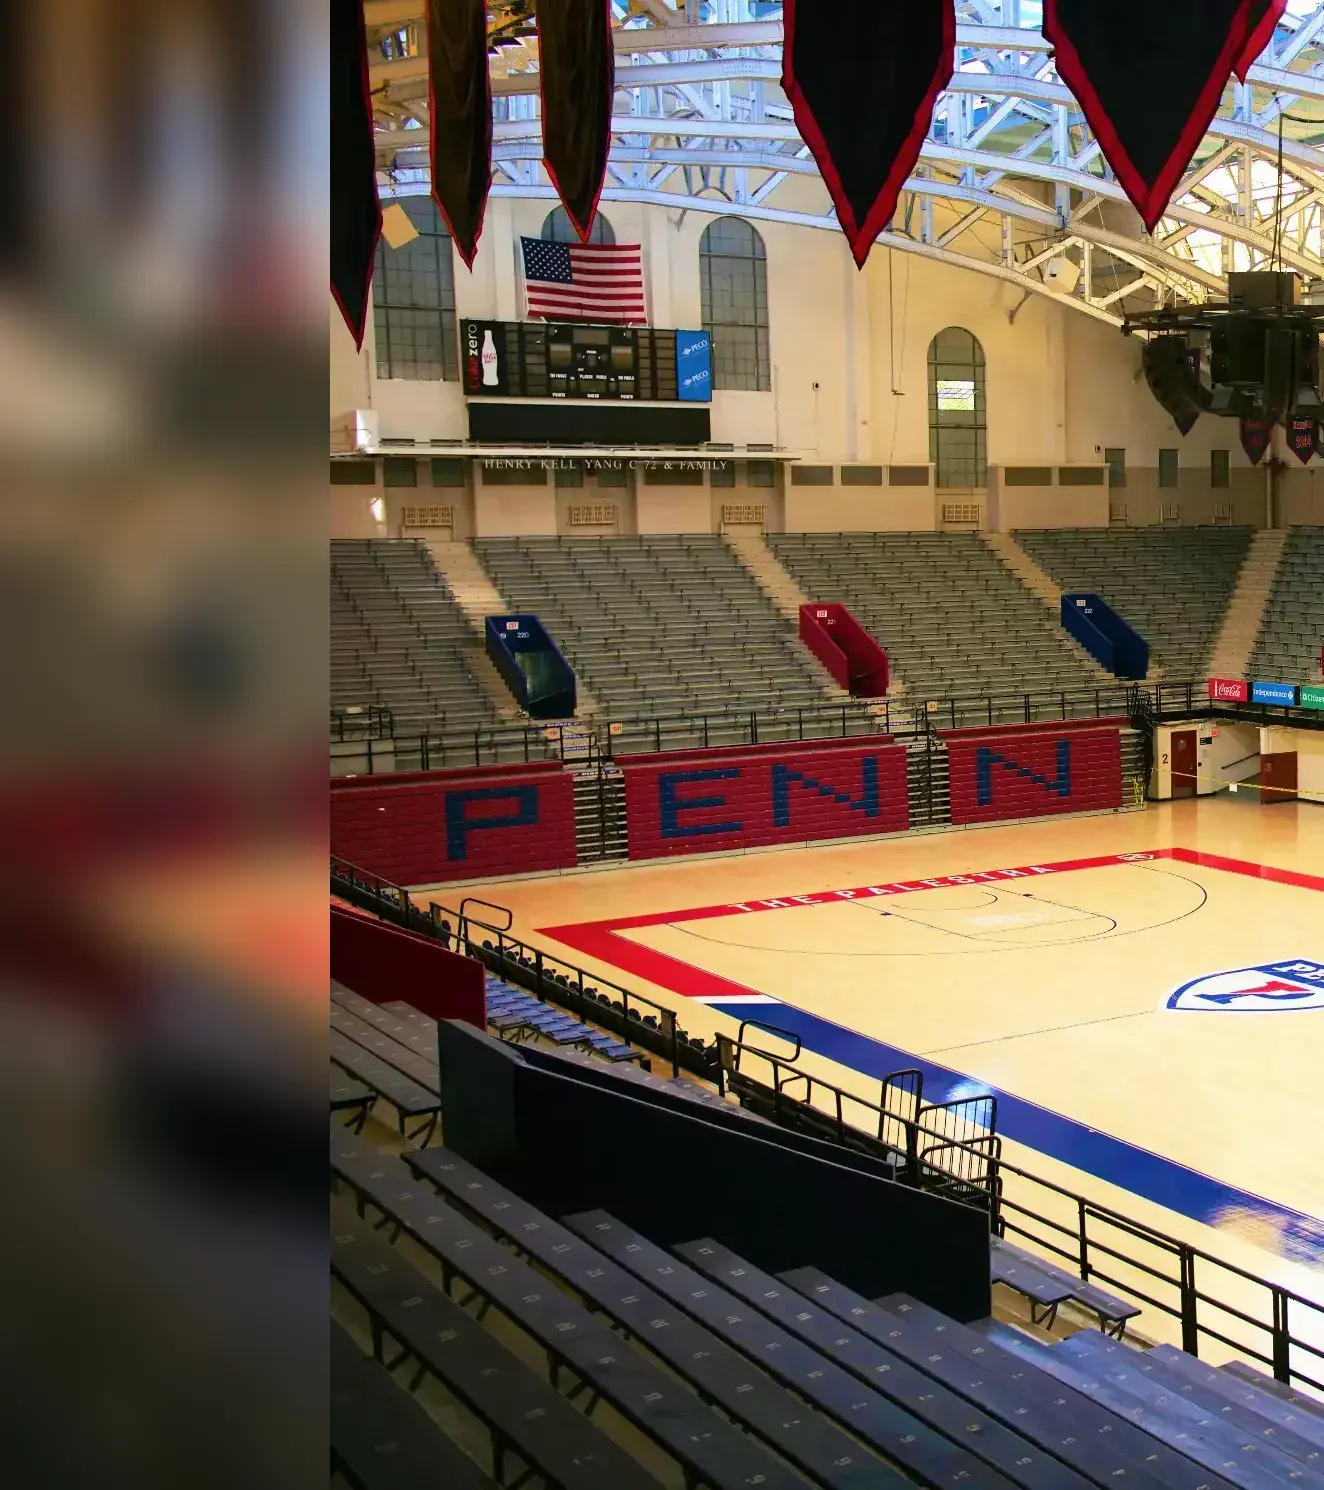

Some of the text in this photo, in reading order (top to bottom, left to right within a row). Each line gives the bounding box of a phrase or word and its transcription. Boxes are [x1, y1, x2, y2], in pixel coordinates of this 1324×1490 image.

[468, 324, 479, 356] zero
[691, 339, 708, 352] PECO
[692, 370, 709, 383] PECO
[484, 458, 533, 470] HENRY
[540, 458, 576, 470] KELL
[585, 458, 623, 470] YANG
[663, 459, 674, 471] &
[679, 460, 728, 471] FAMILY
[1253, 688, 1288, 700] Independence
[1162, 753, 1169, 764] 2
[727, 864, 1057, 914] THE PALESTRA
